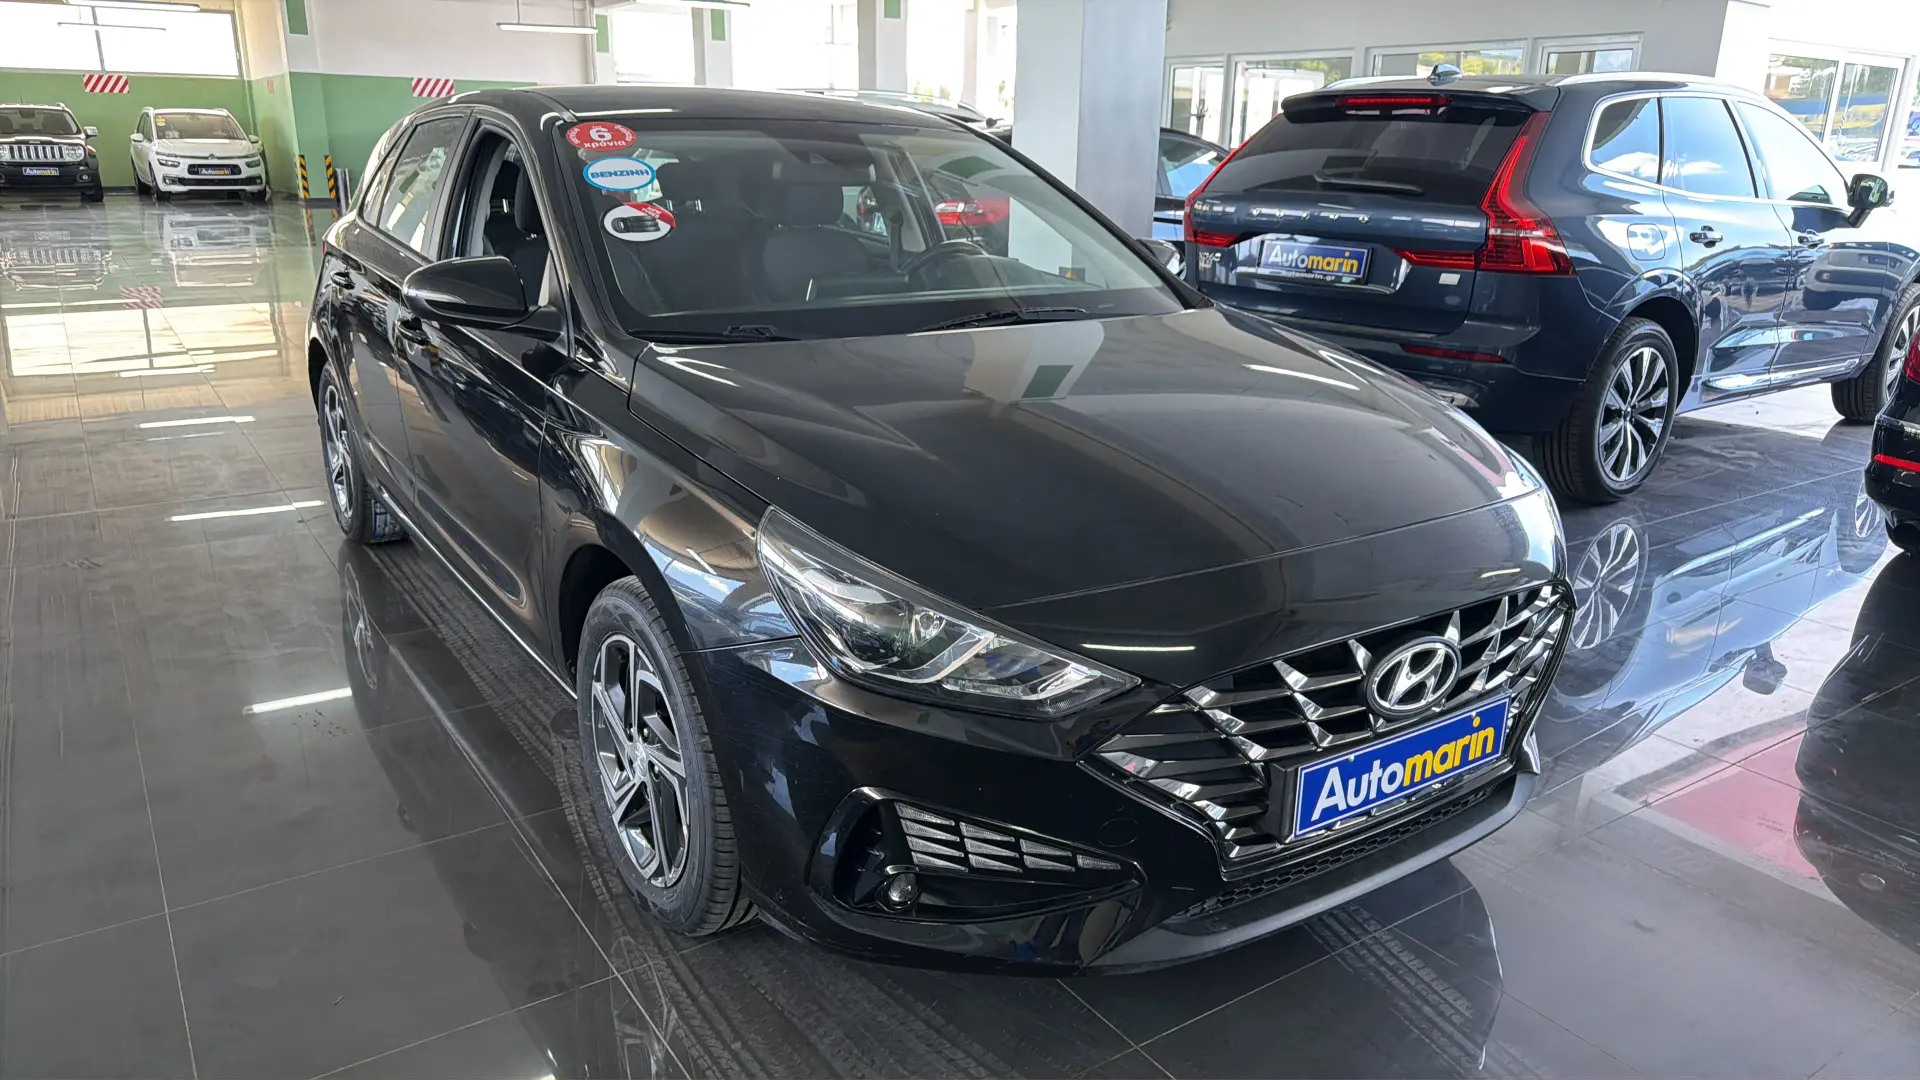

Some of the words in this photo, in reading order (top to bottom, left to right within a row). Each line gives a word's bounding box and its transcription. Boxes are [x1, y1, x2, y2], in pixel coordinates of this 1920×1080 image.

[589, 127, 612, 141] 6
[1269, 245, 1358, 273] Automarin
[1311, 716, 1495, 821] Automarin
